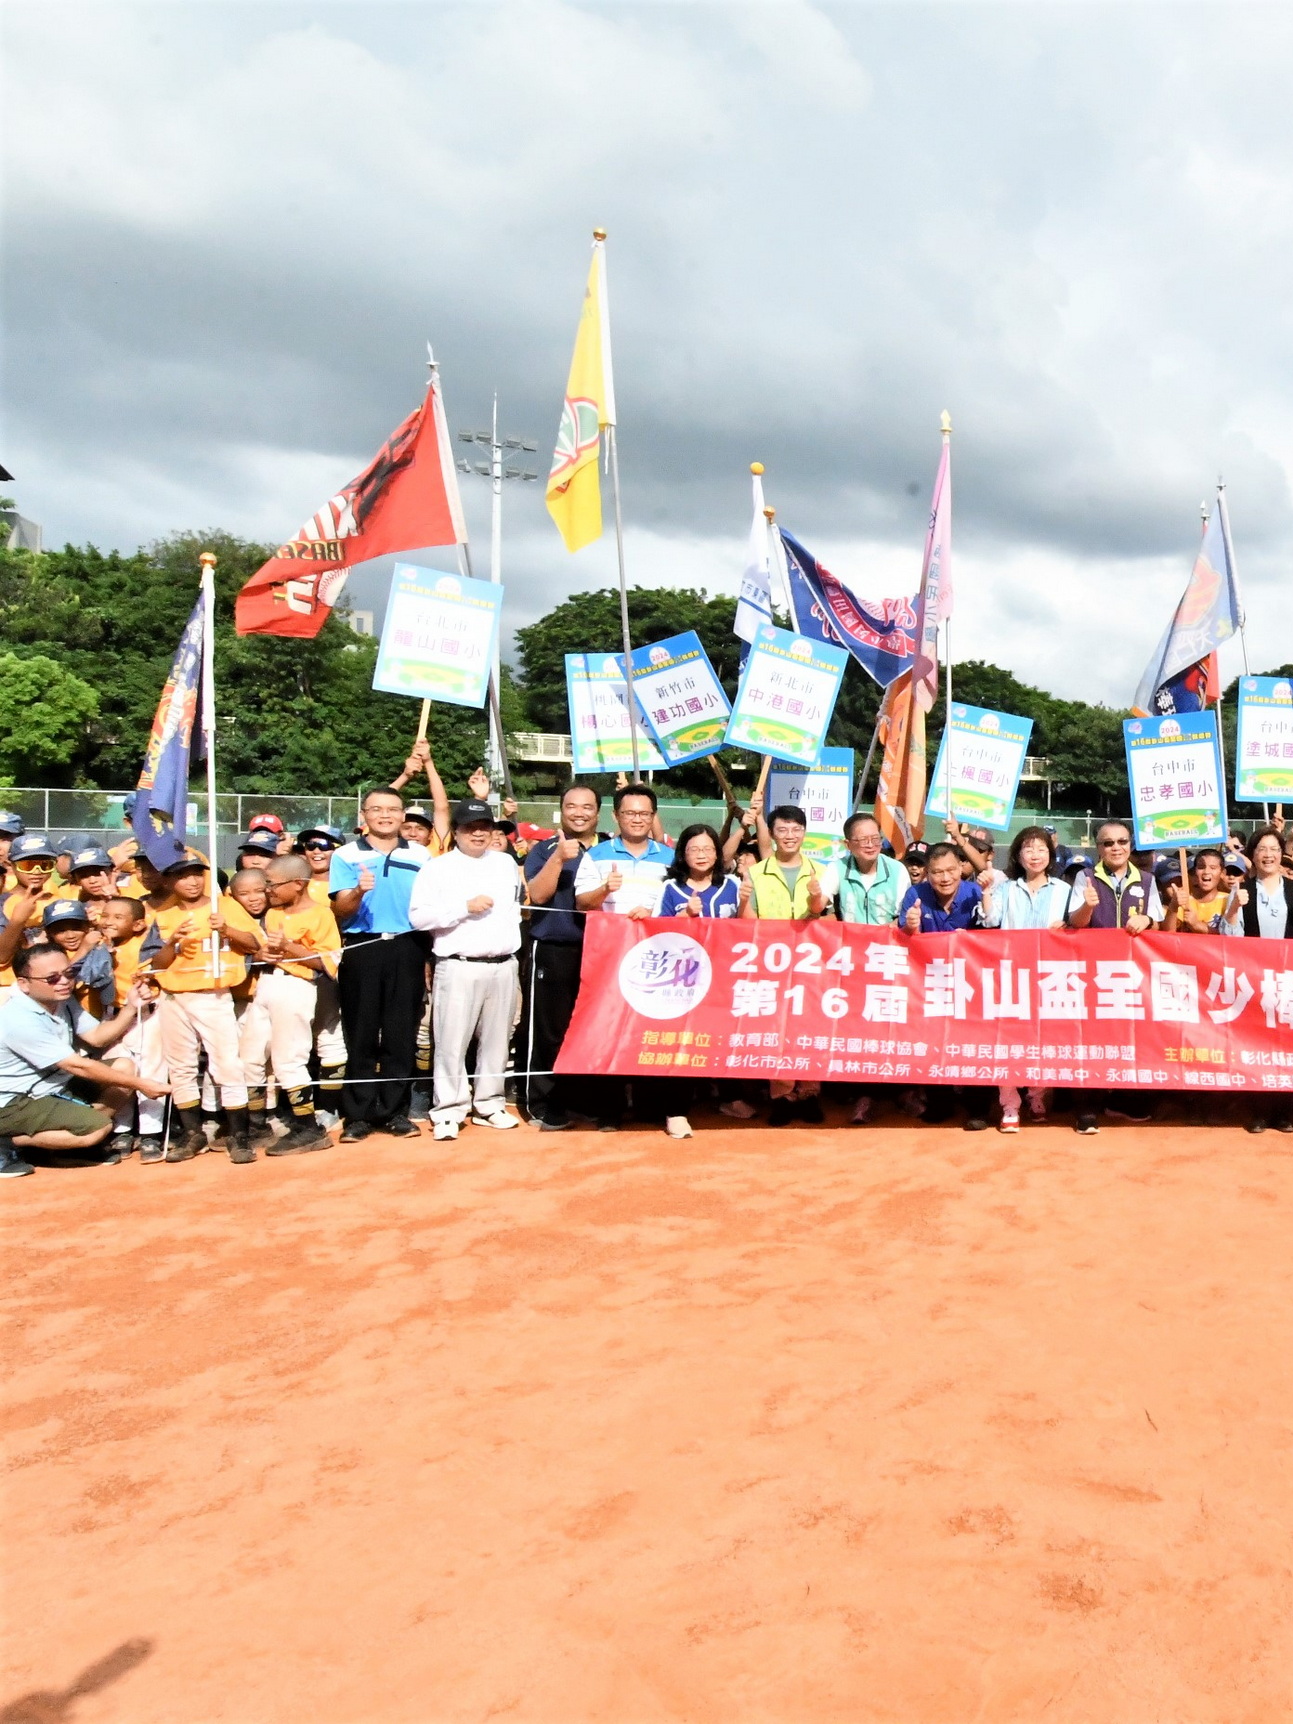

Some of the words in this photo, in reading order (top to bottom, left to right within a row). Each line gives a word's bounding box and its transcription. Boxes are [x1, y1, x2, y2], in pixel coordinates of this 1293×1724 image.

[417, 610, 468, 632] 台北市
[394, 629, 481, 659] 龍山國小
[656, 677, 696, 699] 新竹市
[770, 671, 815, 694] 新北市
[652, 693, 718, 725] 建功國小
[748, 688, 821, 720] 中港國小
[1161, 726, 1179, 734] 2024
[962, 746, 1001, 763] 台中市
[1152, 759, 1195, 776] 台中市
[789, 787, 829, 800] 台中市
[1140, 780, 1213, 802] 忠孝國小
[1165, 829, 1199, 838] BASEBALL
[639, 948, 700, 988] 彰化
[729, 942, 911, 981] 2024年
[730, 979, 909, 1024] 第16屆
